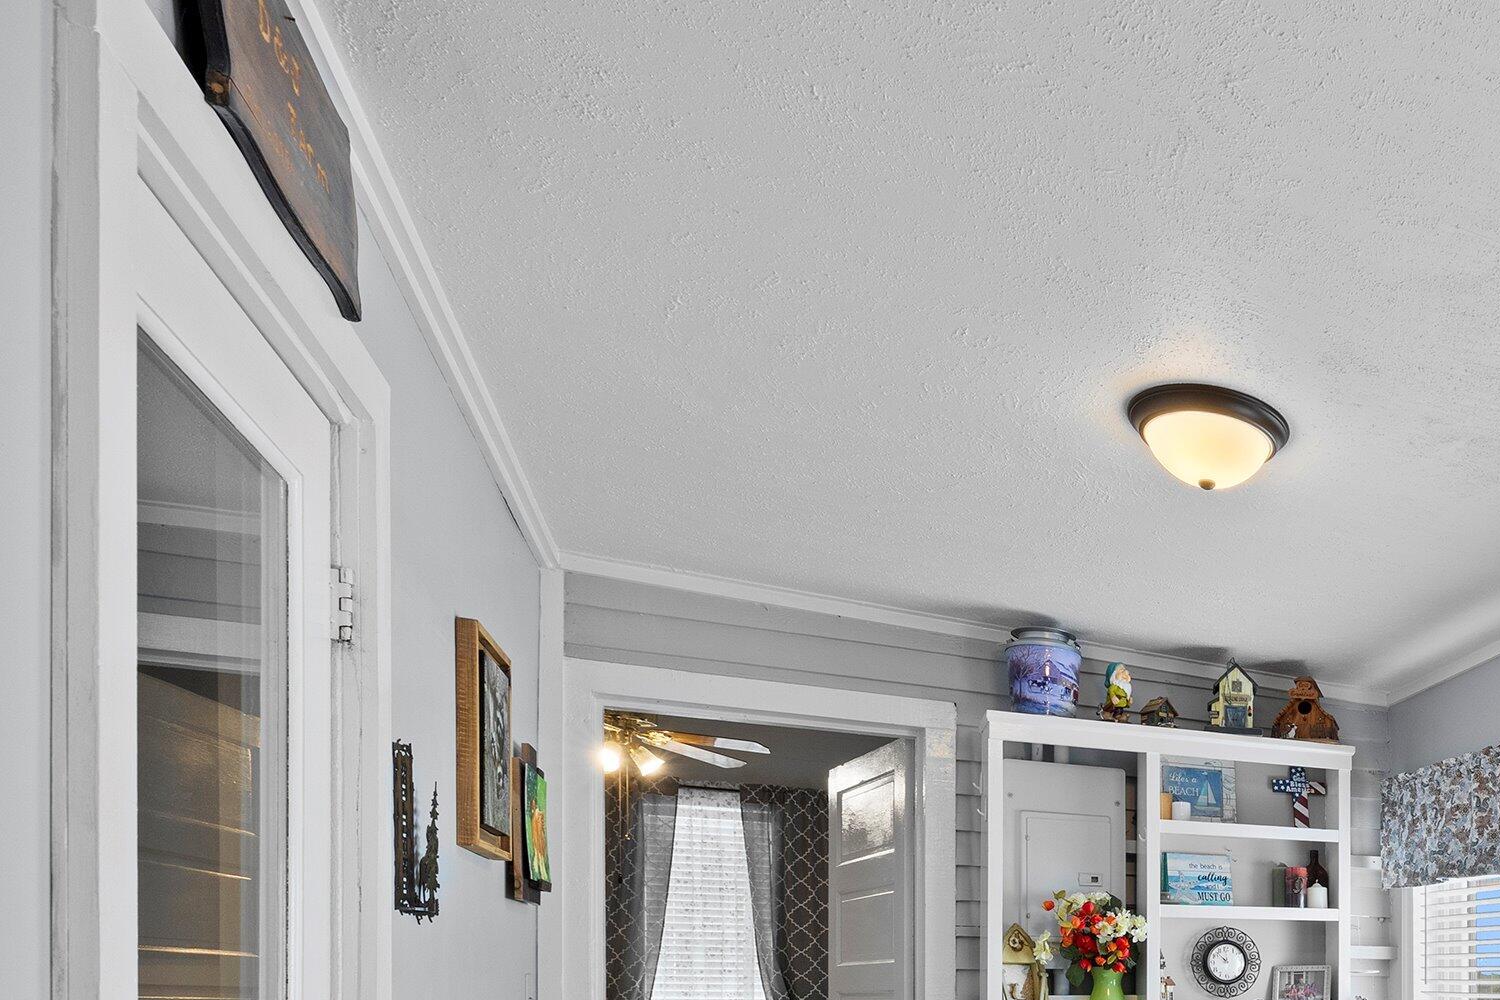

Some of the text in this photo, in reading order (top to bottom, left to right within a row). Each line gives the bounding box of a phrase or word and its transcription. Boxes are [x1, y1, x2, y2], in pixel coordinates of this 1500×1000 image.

[1168, 785, 1199, 797] BEACH
[1197, 871, 1228, 886] calling
[1197, 891, 1231, 902] MUST GO
